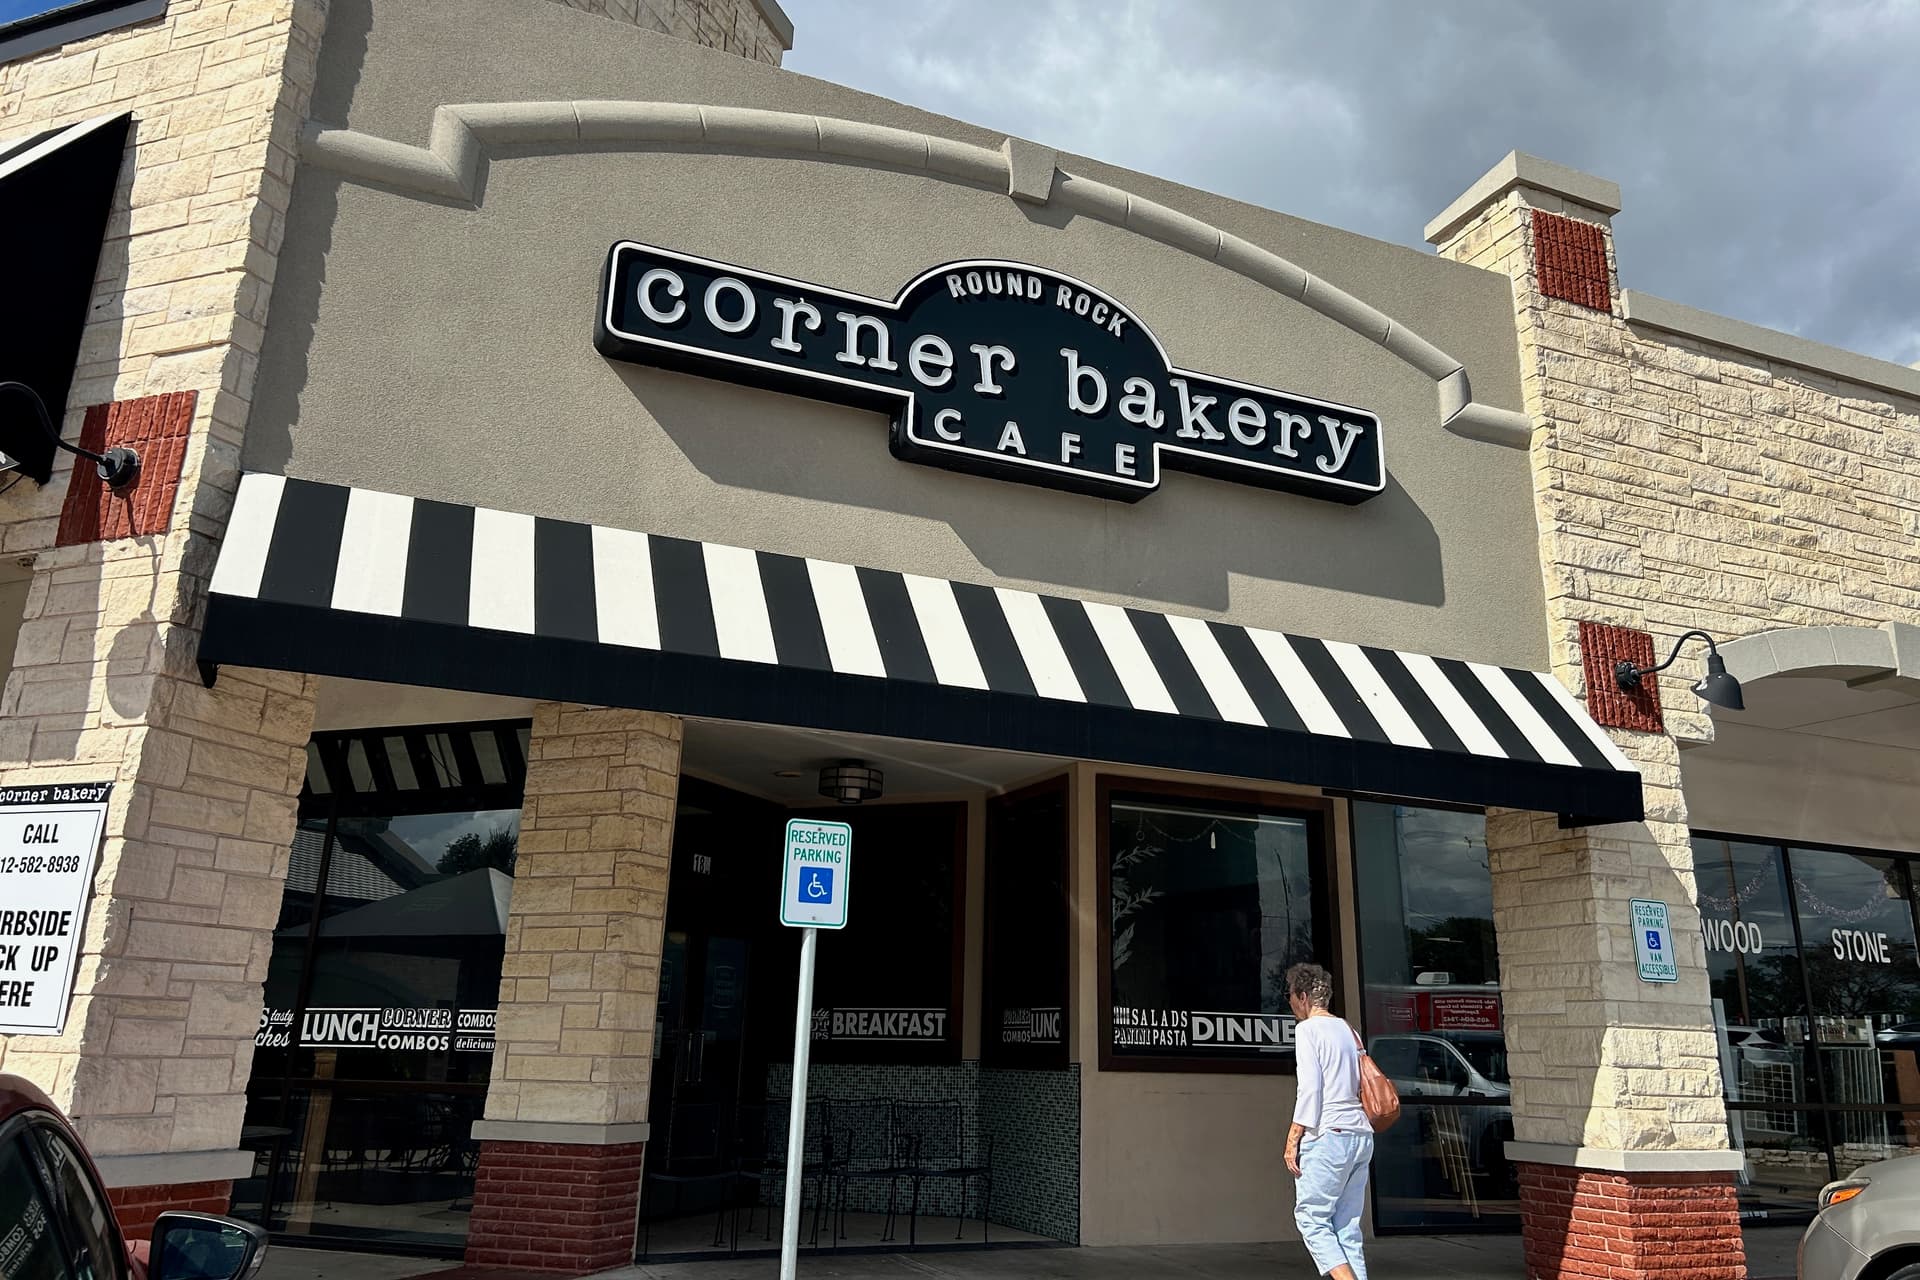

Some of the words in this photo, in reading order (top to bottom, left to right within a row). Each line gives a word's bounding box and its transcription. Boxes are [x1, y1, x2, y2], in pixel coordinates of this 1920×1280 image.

[946, 271, 1044, 301] ROUND
[1055, 285, 1128, 339] ROCK
[636, 267, 1016, 395] corner
[1059, 347, 1364, 474] bakery
[933, 407, 1138, 477] CAFE
[0, 789, 48, 803] corner
[22, 823, 59, 844] CALL
[791, 829, 847, 846] RESERVED
[0, 855, 80, 874] 12-582-8938
[793, 848, 842, 864] PARKING
[1634, 905, 1665, 918] RESERVED
[1637, 917, 1665, 929] PARKING
[1701, 918, 1763, 954] WOOD
[1831, 928, 1892, 964] STONE
[30, 945, 59, 972] UP
[1649, 952, 1663, 963] VAN
[1641, 963, 1675, 976] ACCESSIBLE
[270, 1009, 294, 1028] tasty
[300, 1012, 381, 1042] LUNCH
[382, 1008, 453, 1028] CORNER
[832, 1012, 947, 1037] BREAKFAST
[1131, 1008, 1188, 1028] SALADS
[378, 1035, 450, 1051] COMBOS
[456, 1037, 495, 1050] delicious
[1002, 1030, 1031, 1043] COMBOS
[1113, 1026, 1151, 1046] PANINI
[1152, 1029, 1188, 1047] PASTA
